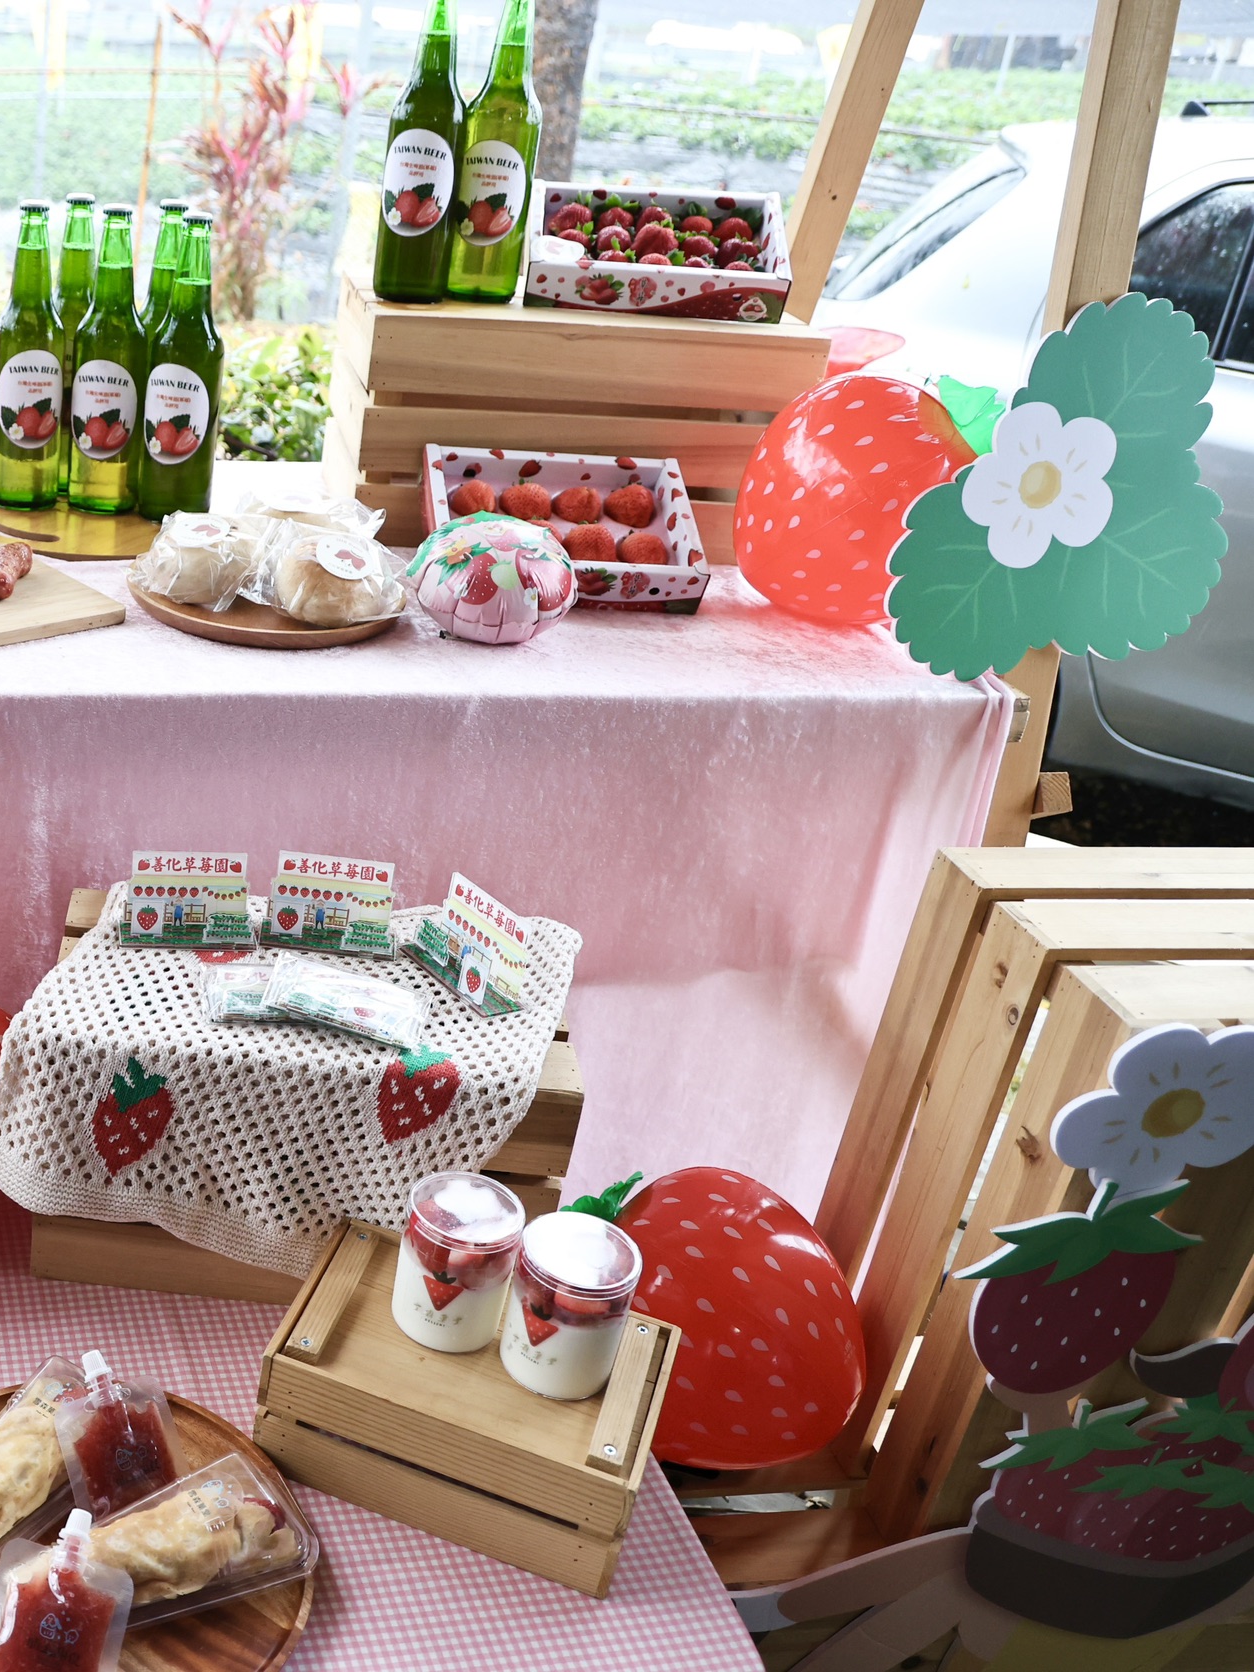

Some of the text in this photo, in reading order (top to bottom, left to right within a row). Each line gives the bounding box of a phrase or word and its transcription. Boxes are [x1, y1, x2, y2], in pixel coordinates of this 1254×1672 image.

[394, 145, 447, 160] TAIWAN BEER
[466, 156, 519, 171] TAIWAN BEER
[9, 365, 59, 375] TAIWAN BEER
[78, 375, 129, 387] TAIWAN BEER
[150, 379, 200, 393] TAIWAN BEER
[151, 855, 229, 873] 善化草莓園
[297, 857, 375, 881] 善化草莓園
[464, 887, 516, 937] 善化草莓園
[32, 1396, 56, 1416] 雪森菓
